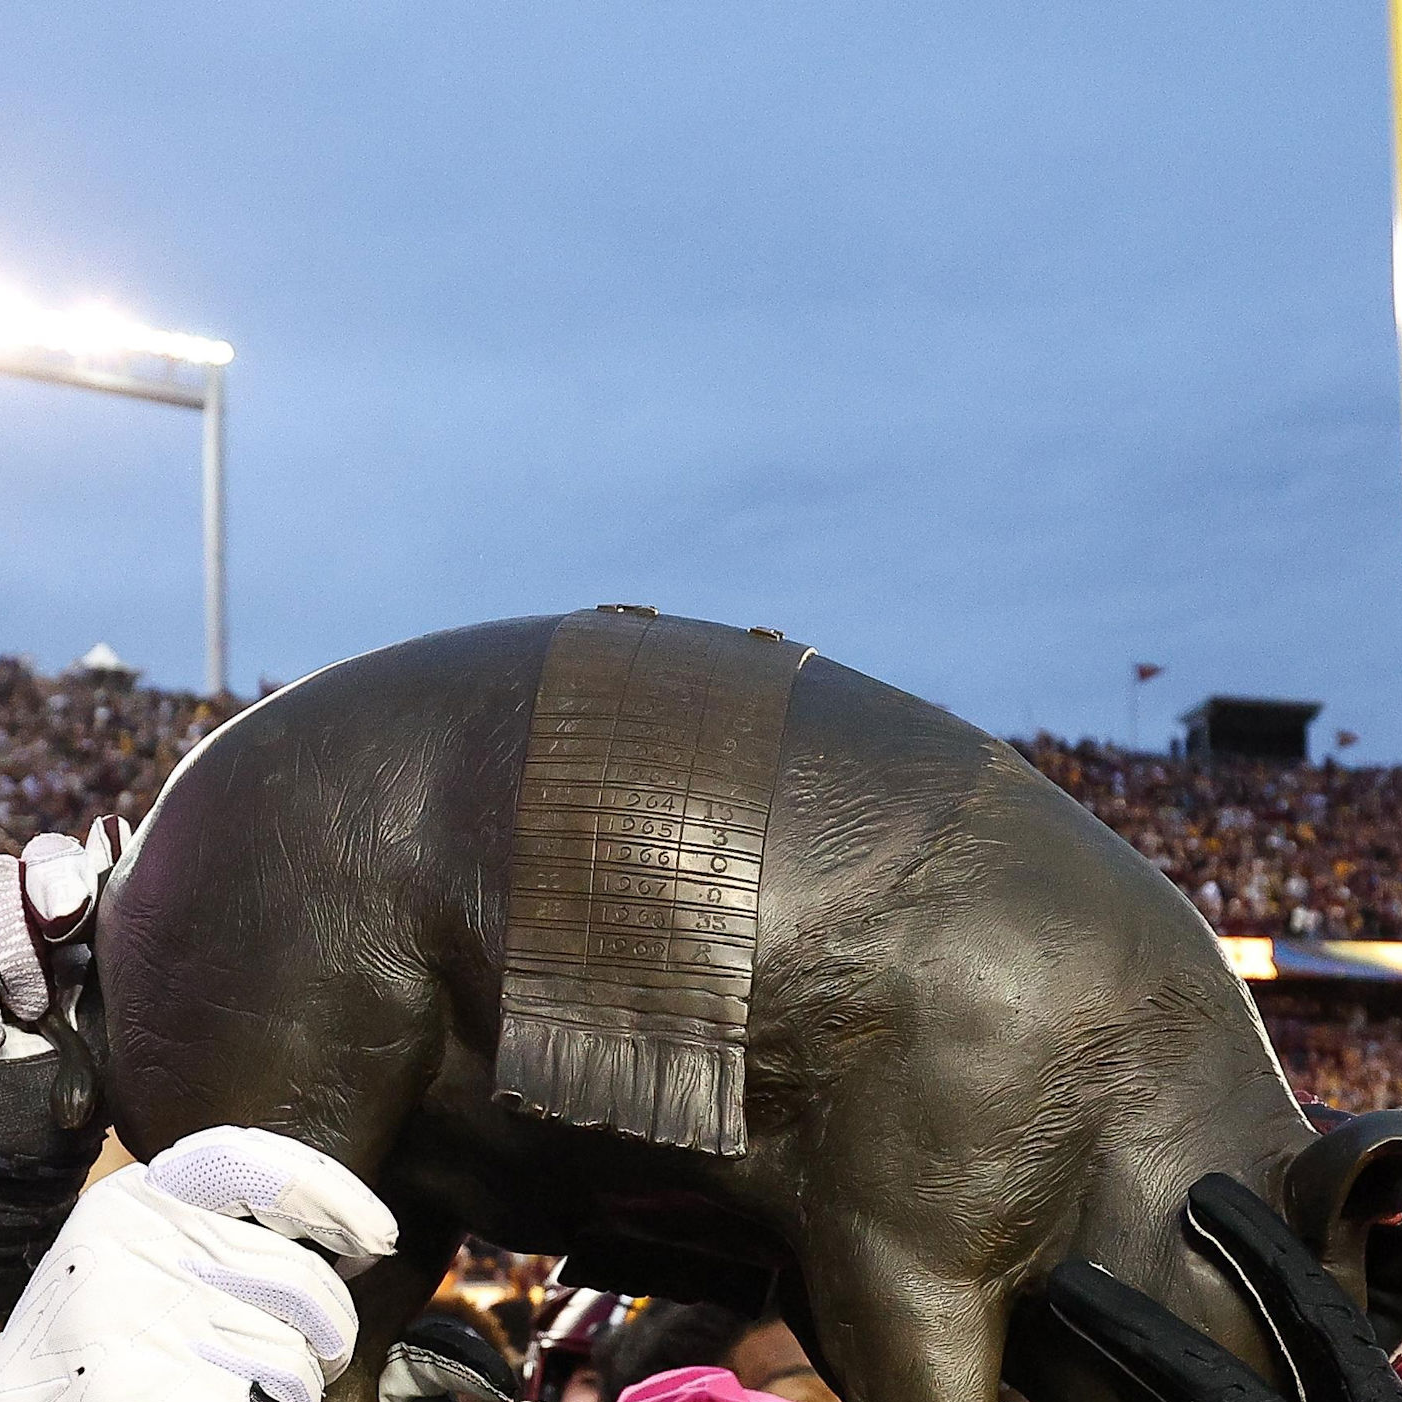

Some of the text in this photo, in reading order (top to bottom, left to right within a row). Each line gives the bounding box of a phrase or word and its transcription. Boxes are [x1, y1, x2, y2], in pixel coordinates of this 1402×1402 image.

[611, 790, 676, 813] 1964
[608, 815, 729, 847] 1965 3
[605, 844, 728, 874] 1966 0
[603, 874, 668, 896] 1967
